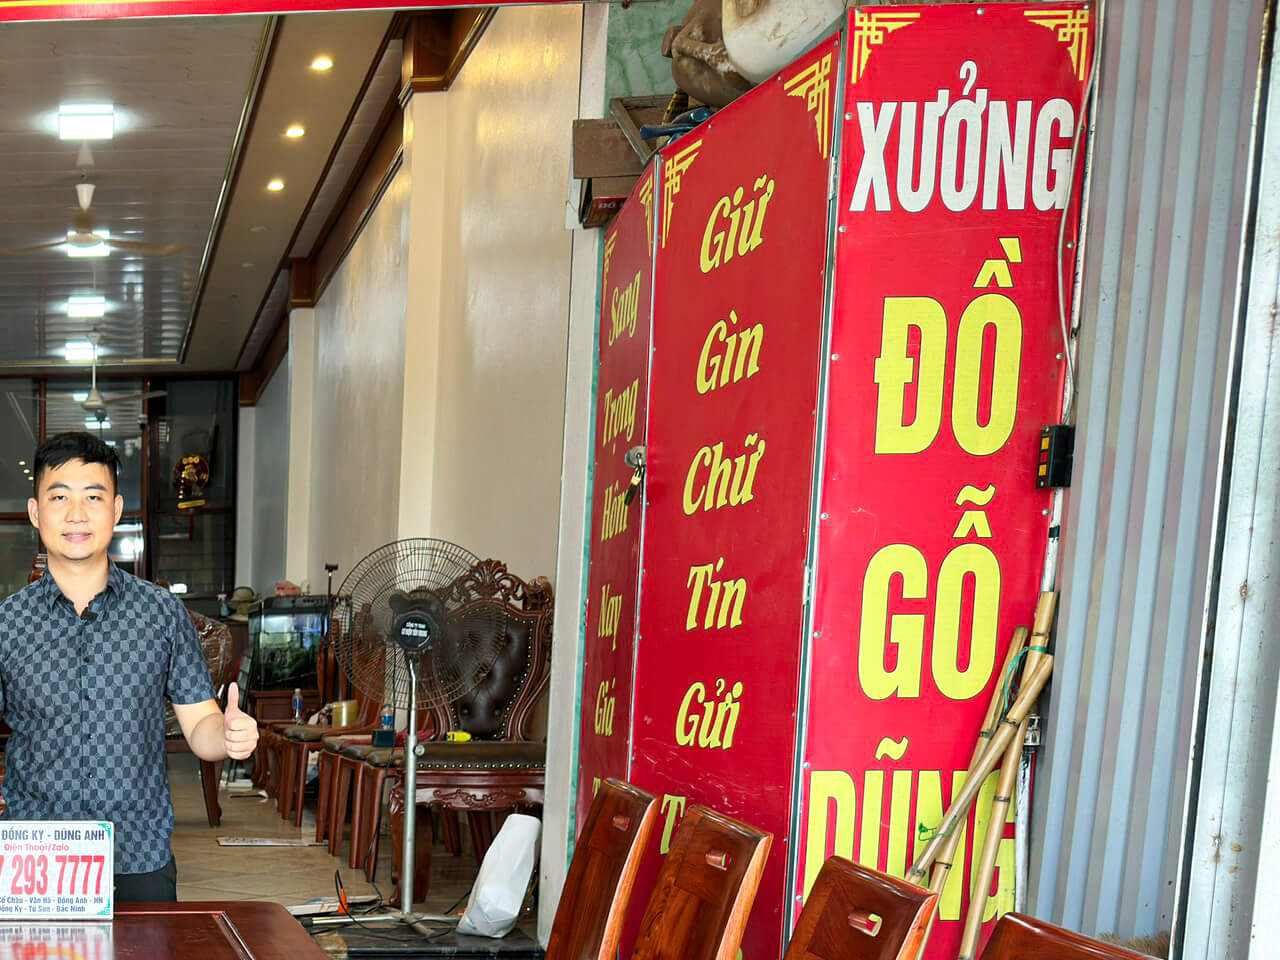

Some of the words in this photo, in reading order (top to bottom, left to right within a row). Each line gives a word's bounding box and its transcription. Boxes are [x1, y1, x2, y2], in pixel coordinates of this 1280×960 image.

[849, 60, 1076, 212] XƯỞNG
[699, 173, 775, 274] Giữ
[608, 270, 641, 347] Sang
[873, 236, 1023, 455] ĐỒ
[696, 309, 764, 395] Gìn
[603, 378, 639, 455] Trọng
[683, 432, 766, 516] Chữ
[597, 583, 622, 651] Nay
[685, 557, 748, 632] Tín
[857, 484, 1002, 701] GỖ
[594, 676, 616, 737] Giá
[674, 677, 745, 750] Gửi
[84, 830, 104, 840] ANH
[11, 854, 48, 895] 293
[56, 855, 104, 895] 7777
